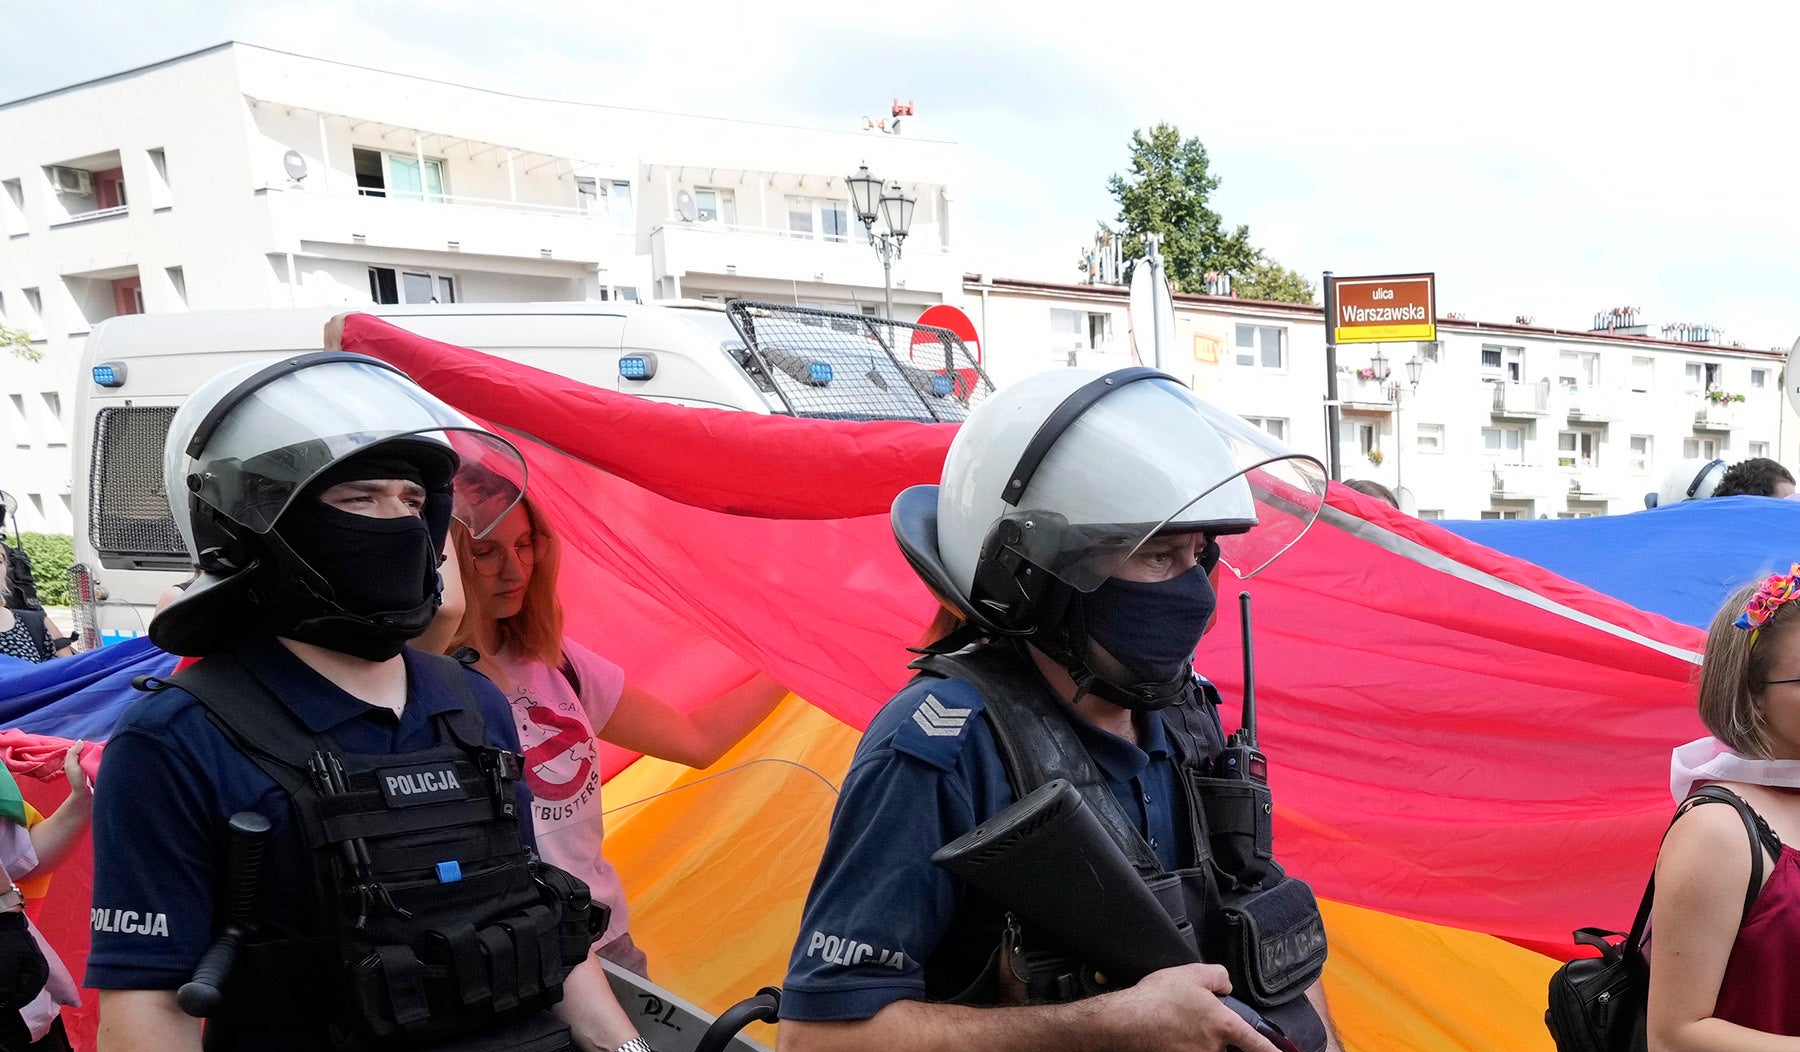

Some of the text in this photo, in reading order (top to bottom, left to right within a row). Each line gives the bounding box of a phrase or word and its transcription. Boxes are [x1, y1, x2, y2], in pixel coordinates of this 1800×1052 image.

[1372, 287, 1394, 300] ulica
[1342, 303, 1425, 322] Warszawska
[385, 770, 461, 796] POLICJA
[90, 907, 169, 937] POLICJA
